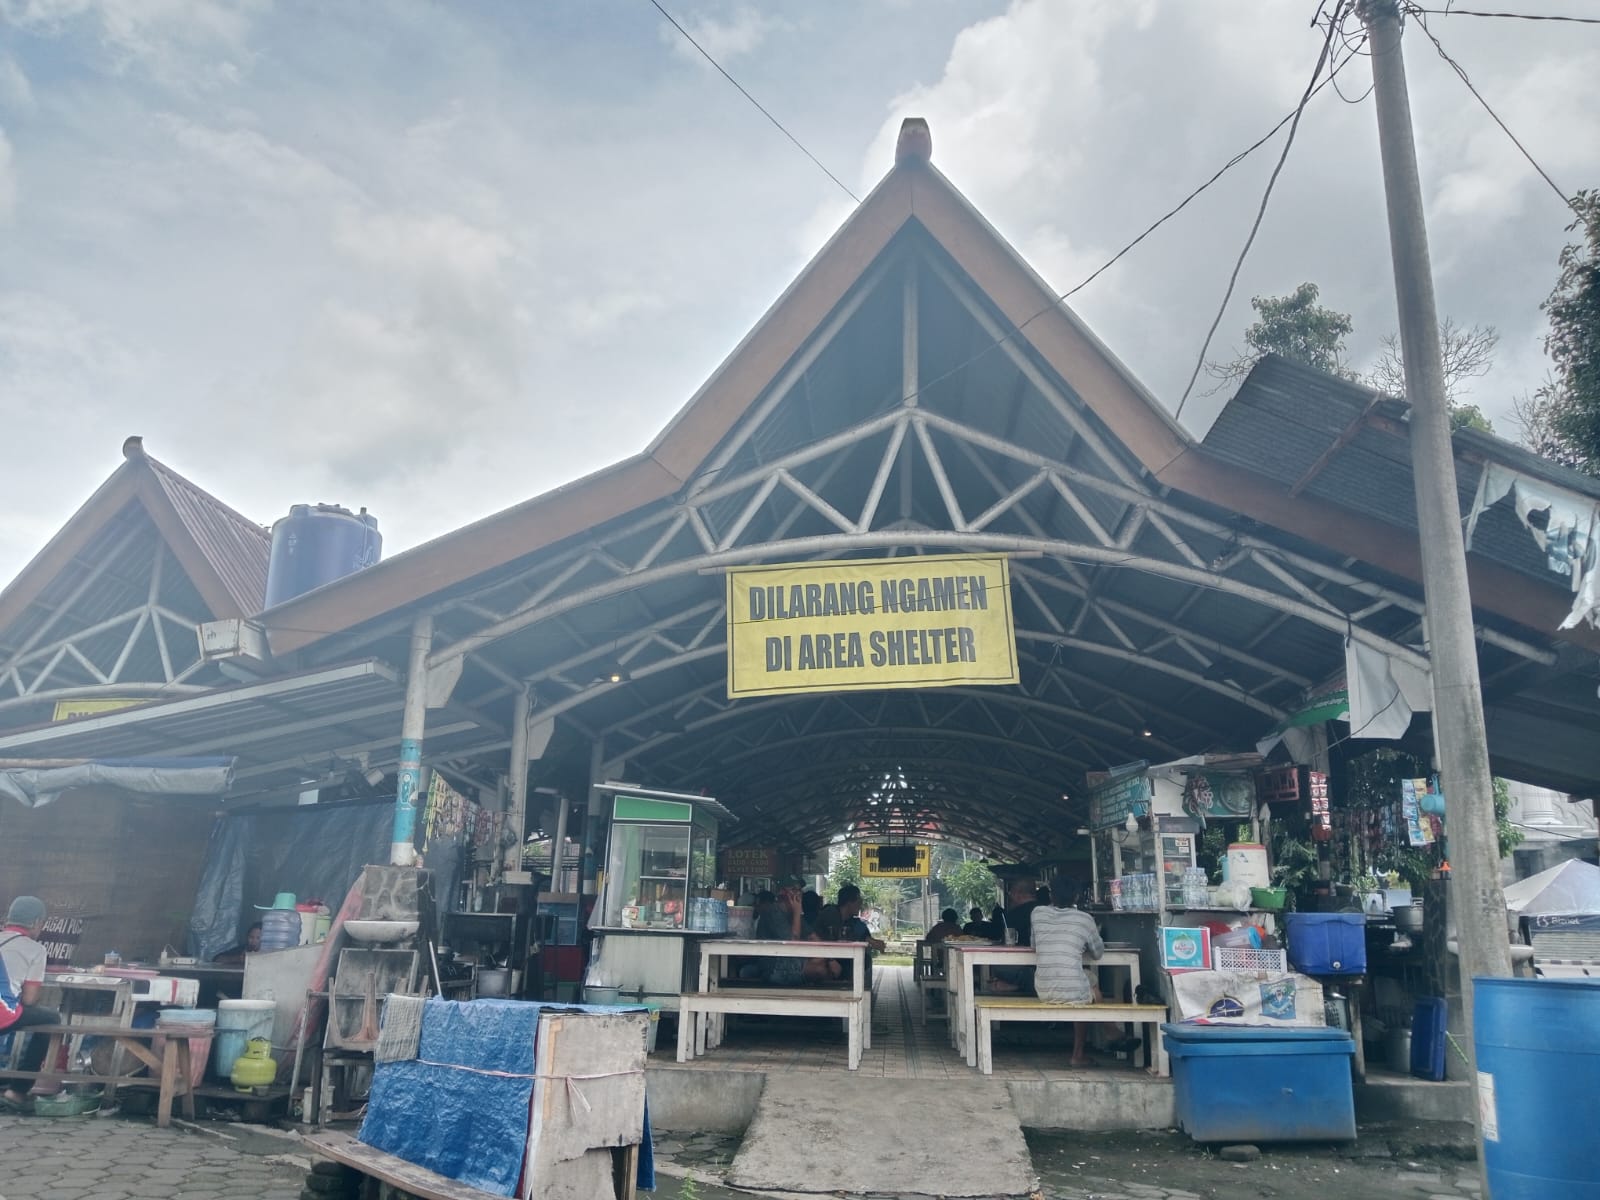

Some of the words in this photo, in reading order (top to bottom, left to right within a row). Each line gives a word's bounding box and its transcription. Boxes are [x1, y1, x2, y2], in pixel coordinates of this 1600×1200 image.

[750, 580, 875, 620] DILARANG
[880, 575, 988, 613] NGAMEN
[765, 636, 792, 672] DI
[798, 632, 865, 670] AREA
[869, 627, 977, 667] SHELTER
[728, 849, 768, 859] LOTEK
